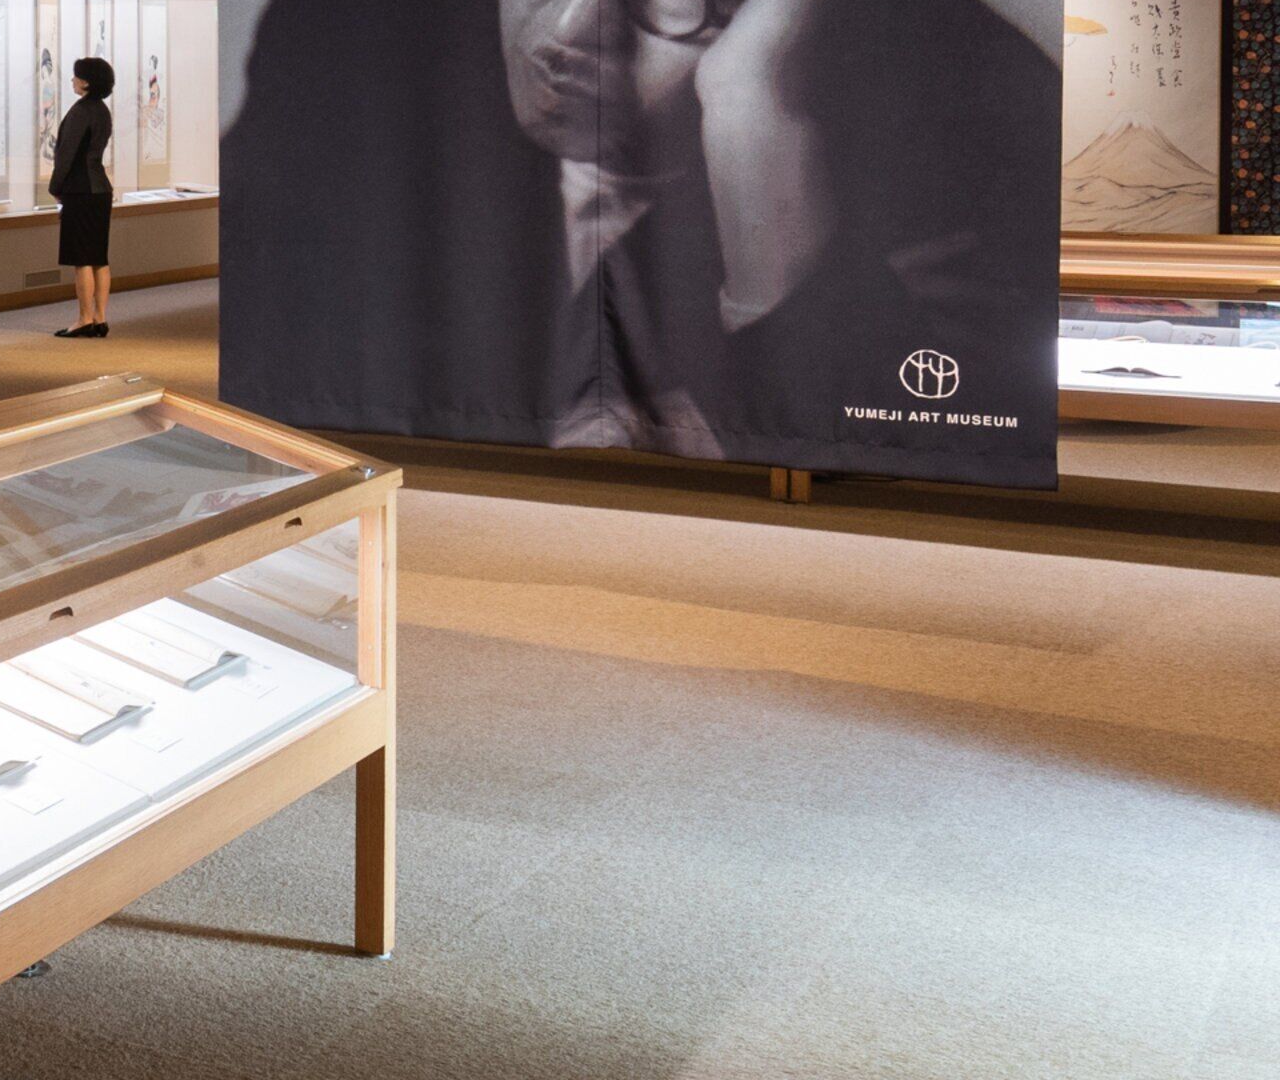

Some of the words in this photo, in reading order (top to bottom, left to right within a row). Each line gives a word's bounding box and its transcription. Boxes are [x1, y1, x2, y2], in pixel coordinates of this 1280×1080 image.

[844, 406, 902, 421] YUMEJI
[908, 411, 941, 423] ART
[947, 413, 1018, 428] MUSEUM
